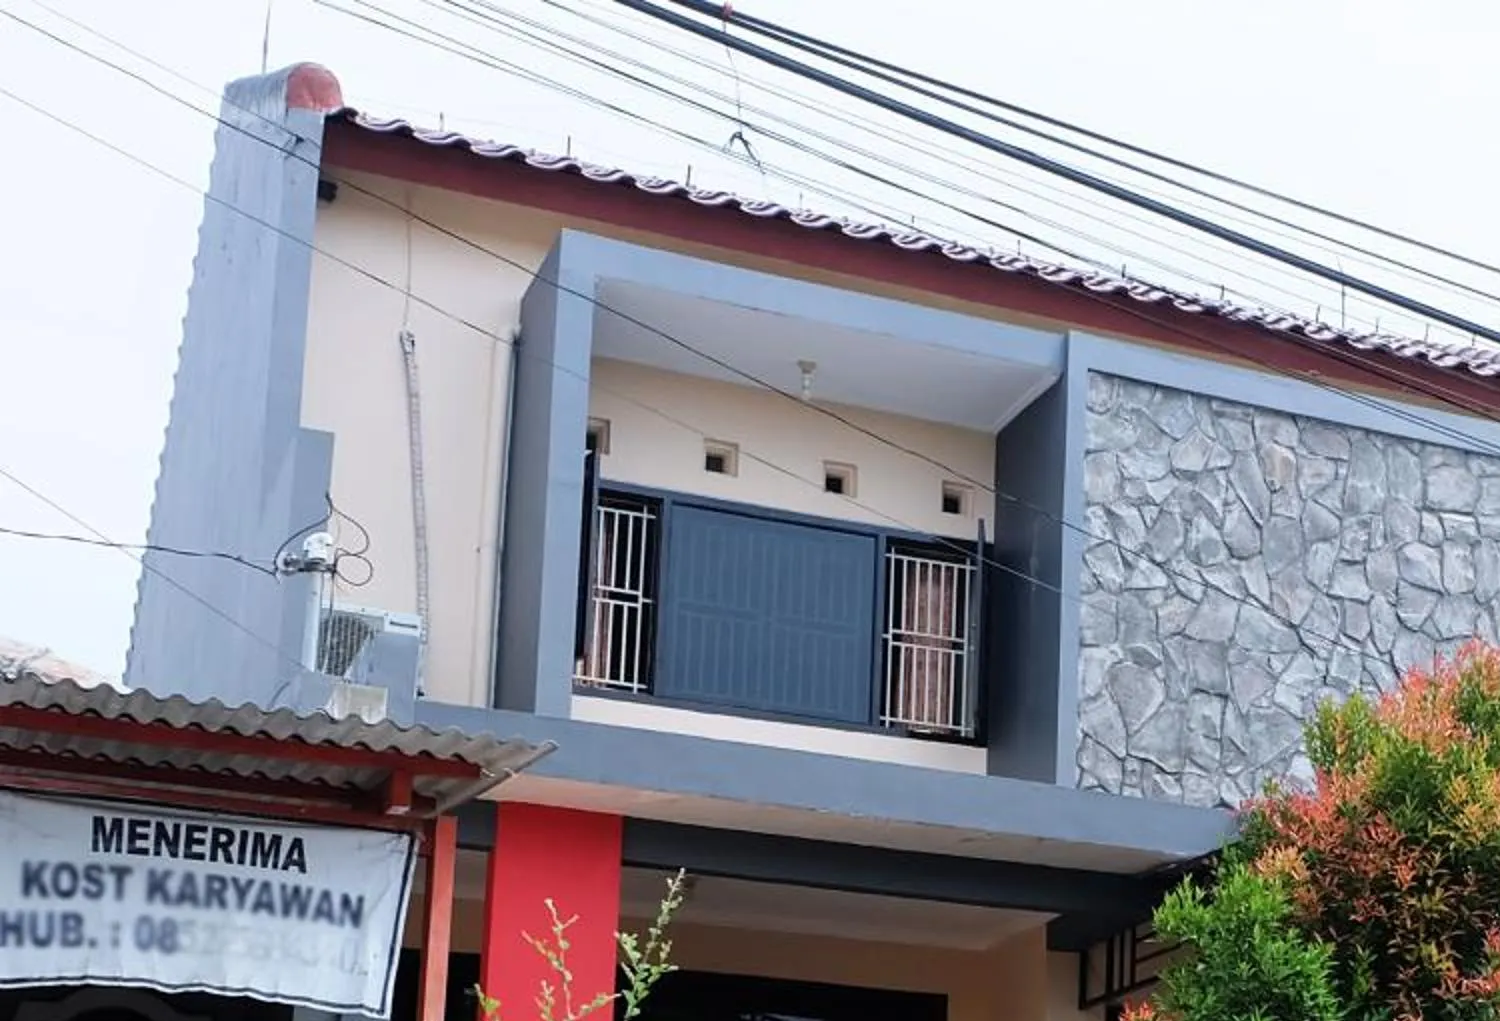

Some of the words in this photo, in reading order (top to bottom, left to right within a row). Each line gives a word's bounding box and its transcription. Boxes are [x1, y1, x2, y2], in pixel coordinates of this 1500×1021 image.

[91, 816, 308, 874] MENERIMA
[21, 860, 133, 901] KOST
[146, 868, 365, 928] KARYAWAN
